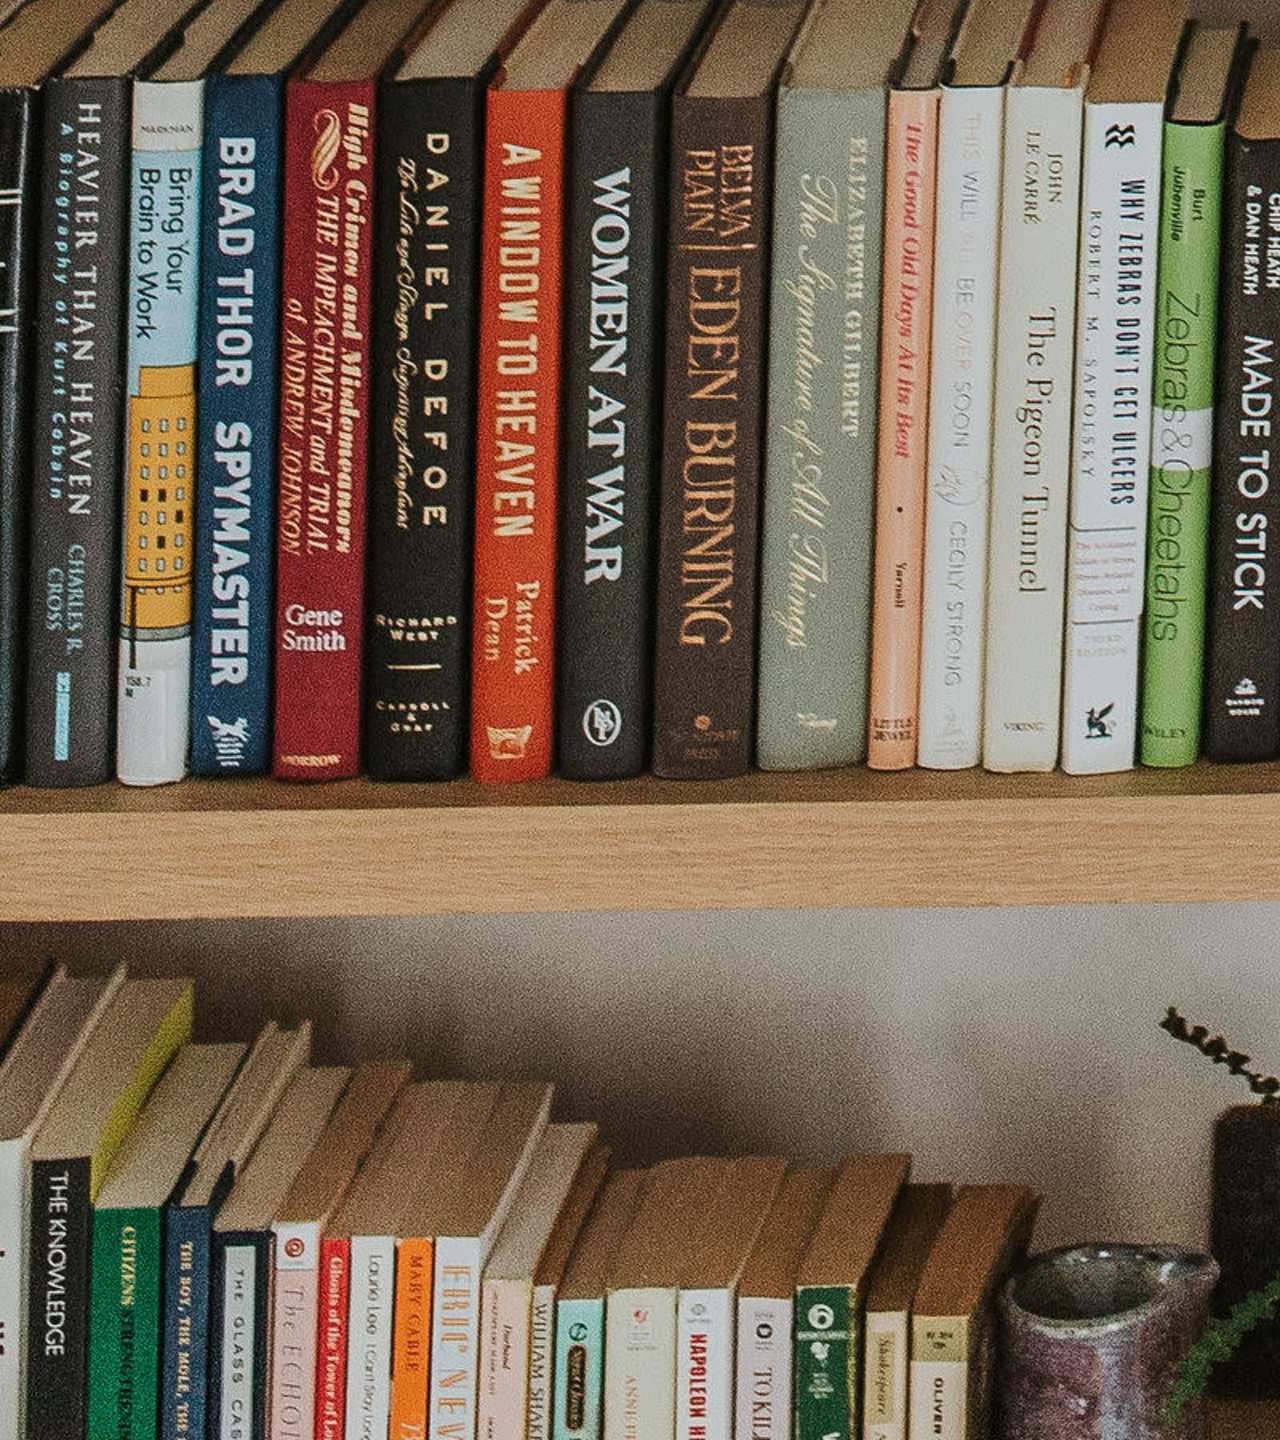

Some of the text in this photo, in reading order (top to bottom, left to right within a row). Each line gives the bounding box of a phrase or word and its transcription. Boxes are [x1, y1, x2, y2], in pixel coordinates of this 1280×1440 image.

[135, 167, 160, 339] Brain to Work
[162, 167, 192, 294] Bring Your
[1243, 185, 1262, 295] & DAN HEATH
[306, 195, 341, 555] THE IMPEACHMENT and TRIAL
[422, 133, 450, 526] DANIEL DEFOE
[584, 166, 631, 585] WOMEN AT WAR
[1015, 152, 1064, 593] JOHN The Pigeon Tunnel
[1109, 180, 1147, 507] WHY ZEBRAS DON'T GET ULCERS
[1240, 335, 1274, 437] MADE
[210, 136, 256, 687] BRAD THOR SPYMASTER
[493, 142, 543, 675] A WINDOW TO HEAVEN Patrick
[679, 144, 754, 647] BELVA EDEN BURNING
[1237, 449, 1269, 498] TO
[284, 603, 344, 627] Gene
[1233, 513, 1266, 611] STICK
[282, 630, 346, 652] Smith
[45, 1171, 69, 1356] THE KNOWLEDGE
[120, 1226, 136, 1306] CITIZENS
[232, 1269, 244, 1384] THE GLASS
[284, 1286, 306, 1330] The
[176, 1241, 193, 1432] THE BOY, THE MOLE, THE
[324, 1256, 343, 1417] Ghosts of the Tower of
[530, 1303, 548, 1379] WILLIAM
[687, 1333, 708, 1420] NAPOLEON
[931, 1378, 944, 1435] OLIVER
